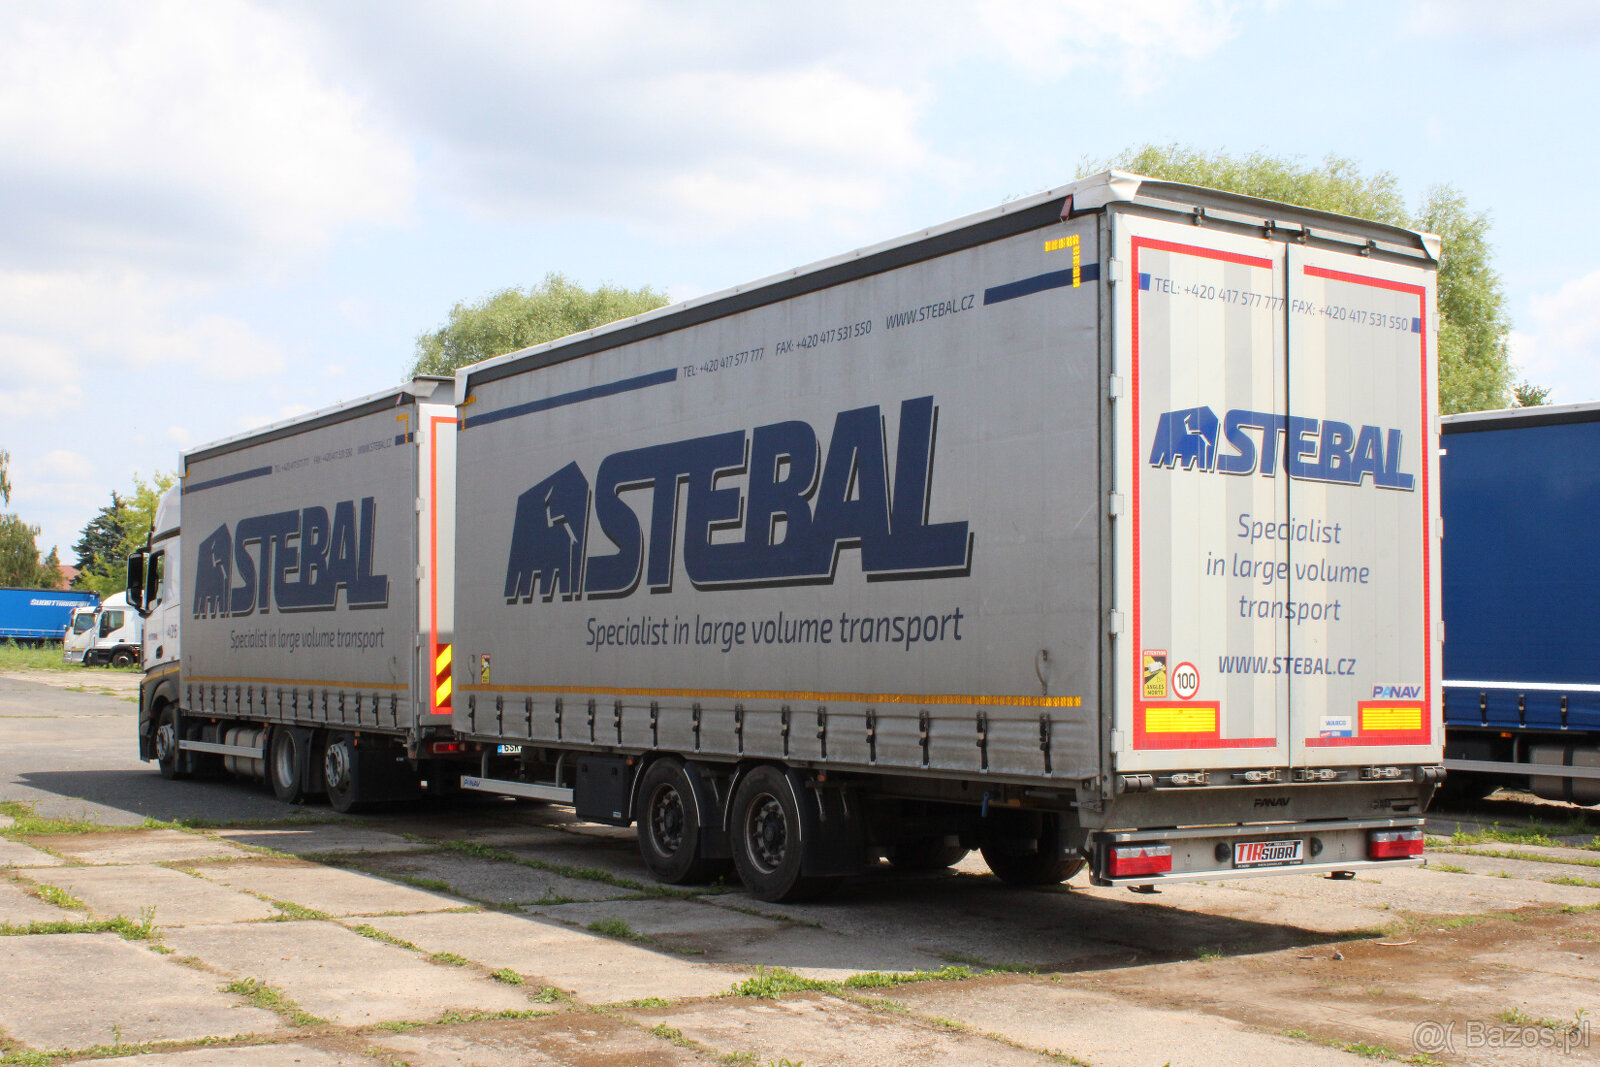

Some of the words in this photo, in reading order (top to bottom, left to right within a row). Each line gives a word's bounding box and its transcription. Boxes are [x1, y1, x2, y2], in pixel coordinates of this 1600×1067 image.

[1155, 278, 1180, 295] TEL:
[1184, 284, 1215, 300] +420
[1218, 288, 1239, 304] 417
[1241, 291, 1262, 308] 577
[1264, 295, 1285, 312] 777
[1291, 299, 1316, 316] FAX:
[1318, 304, 1347, 321] +420
[1349, 309, 1367, 324] 417
[1369, 313, 1387, 328] 531
[1389, 316, 1408, 331] 550
[683, 365, 697, 378] TEL:
[699, 359, 719, 373] +420
[720, 355, 733, 369] 417
[735, 351, 749, 365] 577
[750, 347, 764, 361] 777
[776, 341, 794, 356] FAX:
[796, 334, 818, 350] +420
[820, 329, 836, 344] 417
[837, 325, 853, 341] 531
[854, 320, 872, 337] 550
[886, 294, 975, 329] WWW.STEBAL.CZ
[1216, 409, 1415, 492] STEBAL
[584, 395, 975, 601] STEBAL
[1237, 513, 1342, 545] Specialist
[231, 496, 390, 618] STEBAL
[1207, 551, 1225, 577] in
[1232, 553, 1288, 585] large
[1295, 558, 1370, 584] volume
[1239, 595, 1342, 625] transport
[230, 630, 268, 650] Specialist
[268, 630, 277, 647] in
[278, 630, 300, 653] large
[302, 627, 335, 648] volume
[336, 627, 385, 653] transport
[586, 616, 670, 651] Specialist
[673, 616, 690, 645] in
[694, 616, 745, 653] large
[751, 611, 833, 645] volume
[840, 607, 965, 652] transport
[1177, 673, 1196, 689] 100
[1218, 656, 1356, 675] WWW.STEBAL.CZ
[1372, 685, 1421, 698] PANAV
[1254, 797, 1290, 808] PANAV
